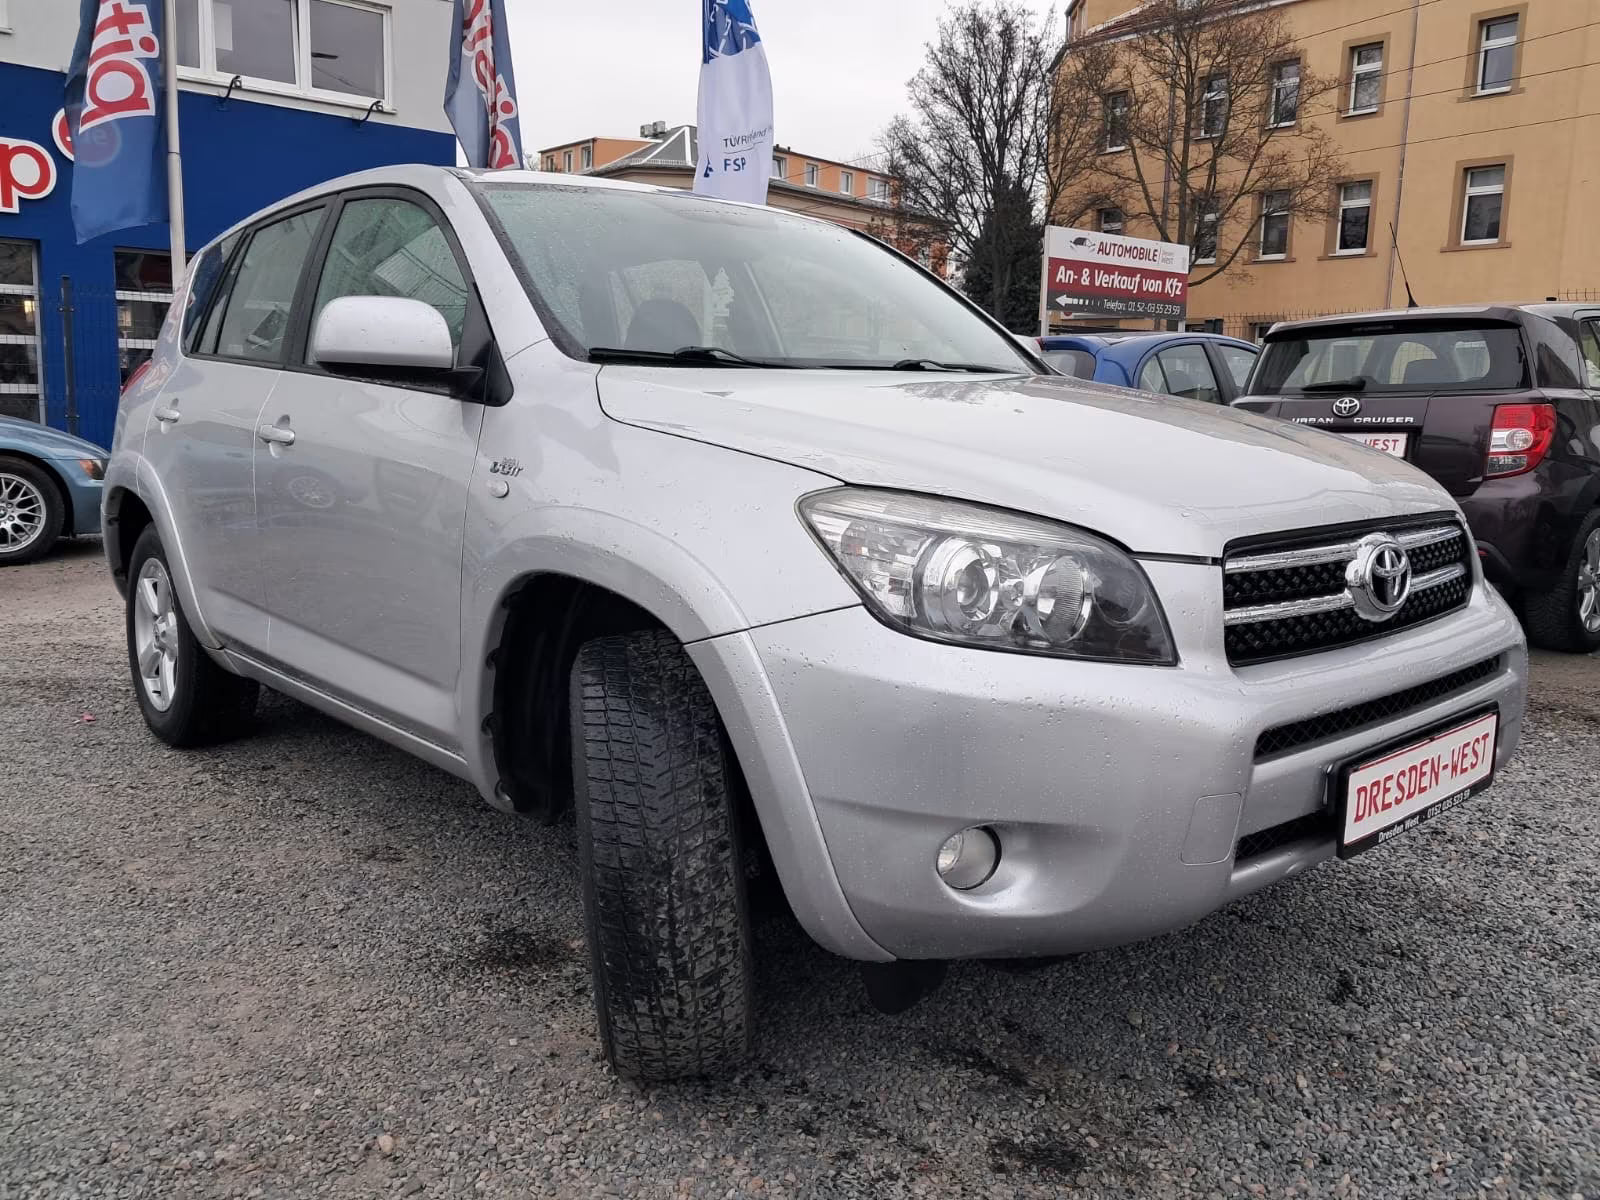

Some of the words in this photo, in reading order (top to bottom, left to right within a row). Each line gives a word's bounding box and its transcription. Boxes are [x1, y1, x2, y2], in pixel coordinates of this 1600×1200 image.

[724, 157, 746, 172] FSP
[1097, 241, 1158, 262] AUTOMOBILE
[1056, 265, 1078, 284] An-
[1081, 267, 1090, 286] &
[1094, 269, 1141, 294] Verkauf
[1142, 278, 1162, 293] von
[1164, 277, 1183, 297] Kfz
[1353, 732, 1490, 824] DRESDEN-WEST
[1378, 825, 1403, 843] Dresden
